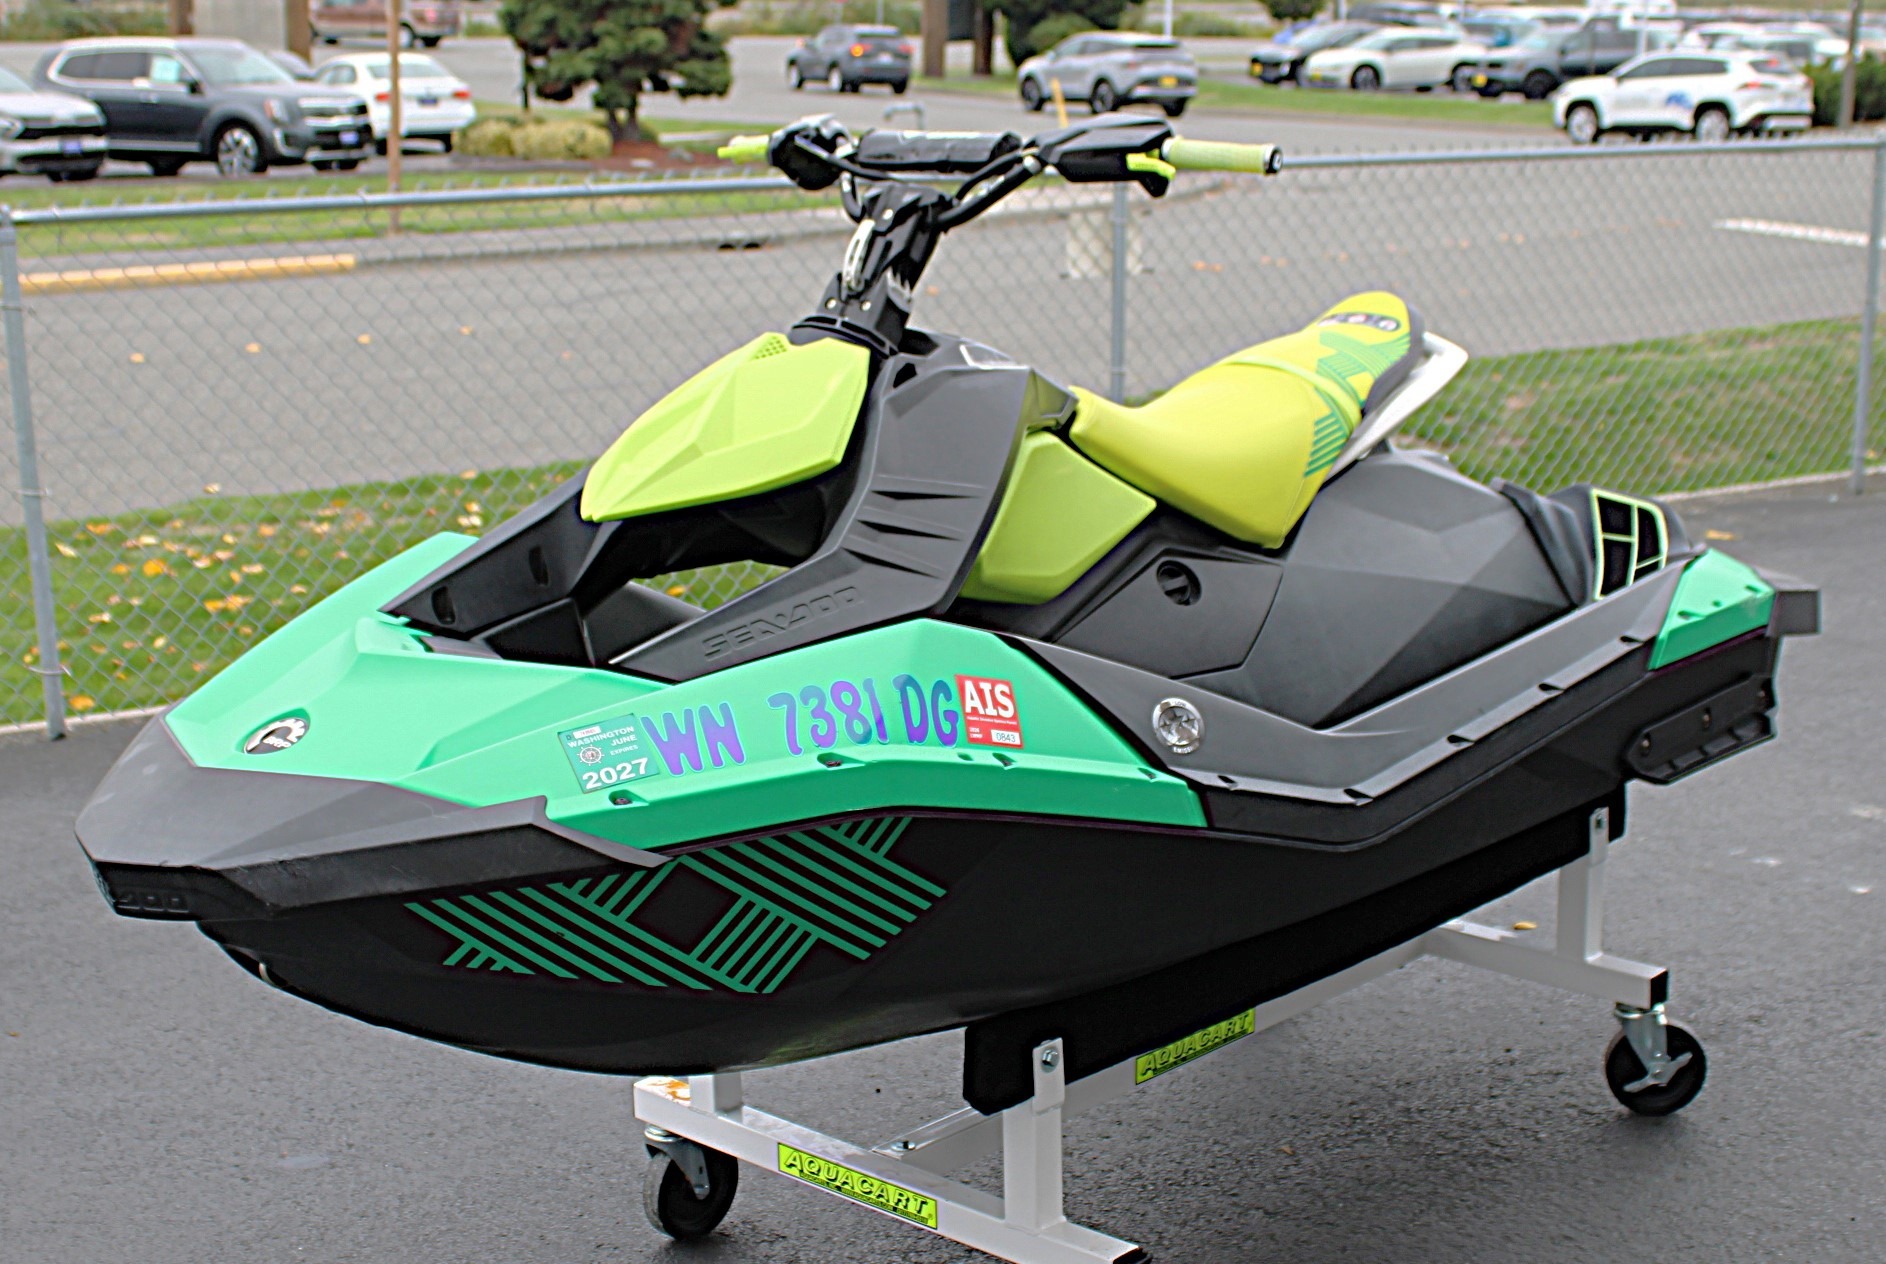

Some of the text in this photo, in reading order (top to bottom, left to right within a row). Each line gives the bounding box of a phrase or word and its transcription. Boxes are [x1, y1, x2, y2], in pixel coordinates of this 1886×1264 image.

[964, 680, 1015, 718] AIS
[567, 726, 635, 748] WASHINGTON
[610, 734, 637, 746] JUNE
[642, 673, 959, 777] WN 7381 DG
[610, 745, 638, 756] EXPIRES
[582, 757, 648, 789] 2027
[1141, 1013, 1249, 1075] AQUACART
[785, 1150, 929, 1215] AQUACART
